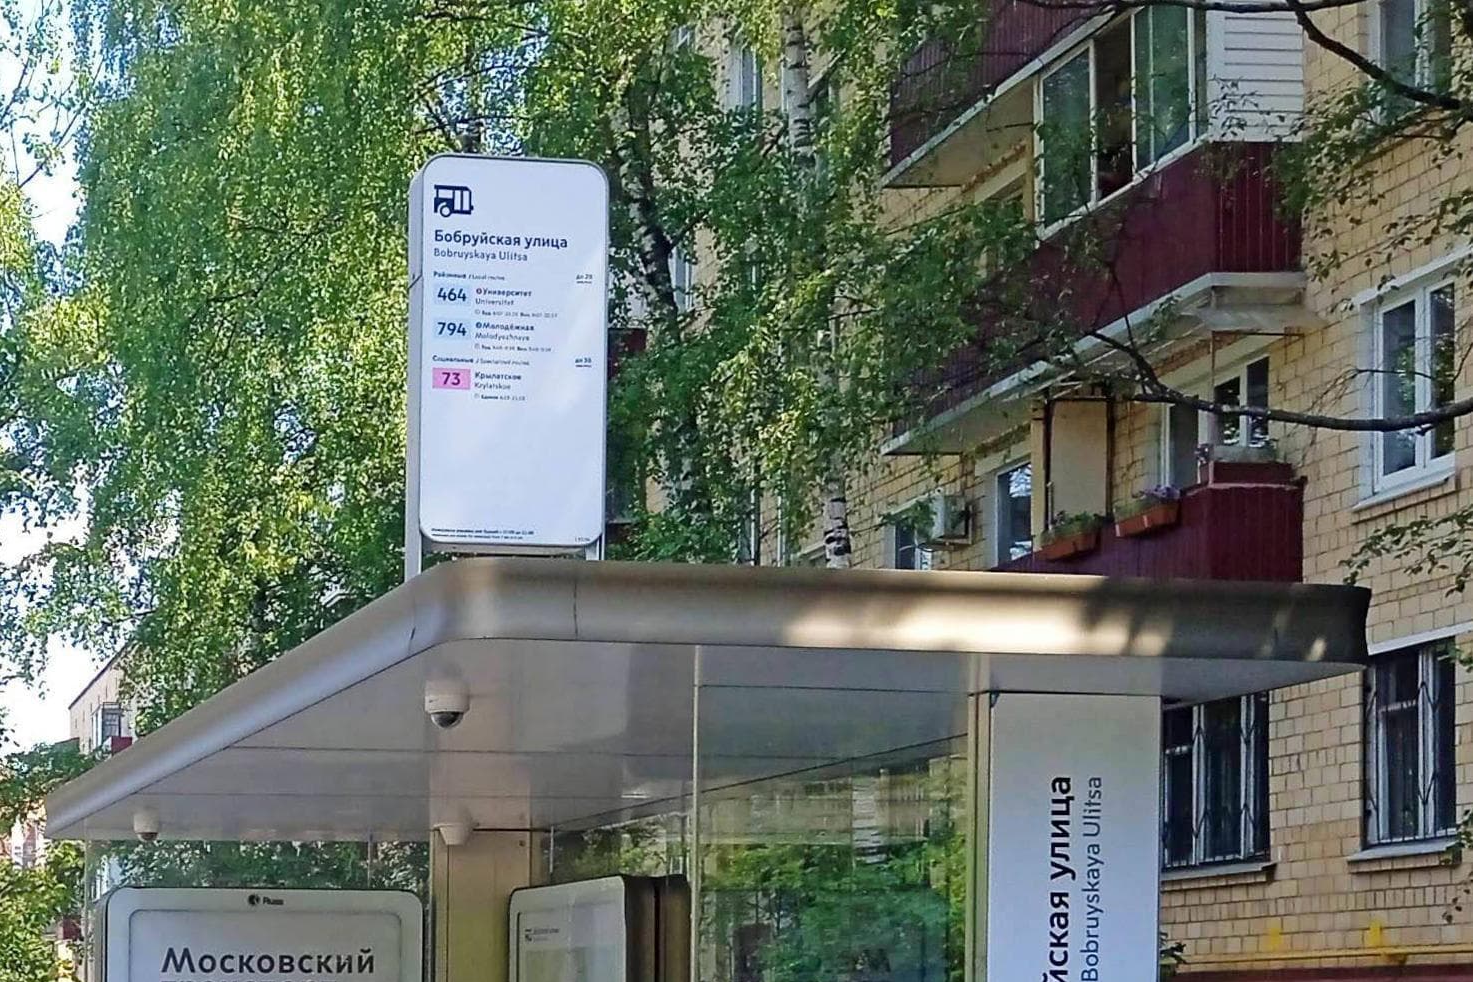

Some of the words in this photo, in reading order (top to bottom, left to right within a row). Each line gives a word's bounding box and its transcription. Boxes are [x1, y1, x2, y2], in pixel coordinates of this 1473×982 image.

[434, 229, 521, 247] Бобруйская
[524, 237, 568, 250] улица
[433, 247, 496, 261] Bobruyskaya
[498, 250, 528, 261] Ulitsa
[437, 287, 467, 302] 464
[482, 288, 532, 297] Университет
[437, 321, 467, 336] 794
[442, 372, 461, 386] 73
[1083, 776, 1103, 837] Ulitsa
[1050, 776, 1076, 881] улица
[1080, 843, 1105, 982] Bobruyskaya
[161, 947, 375, 974] Московский
